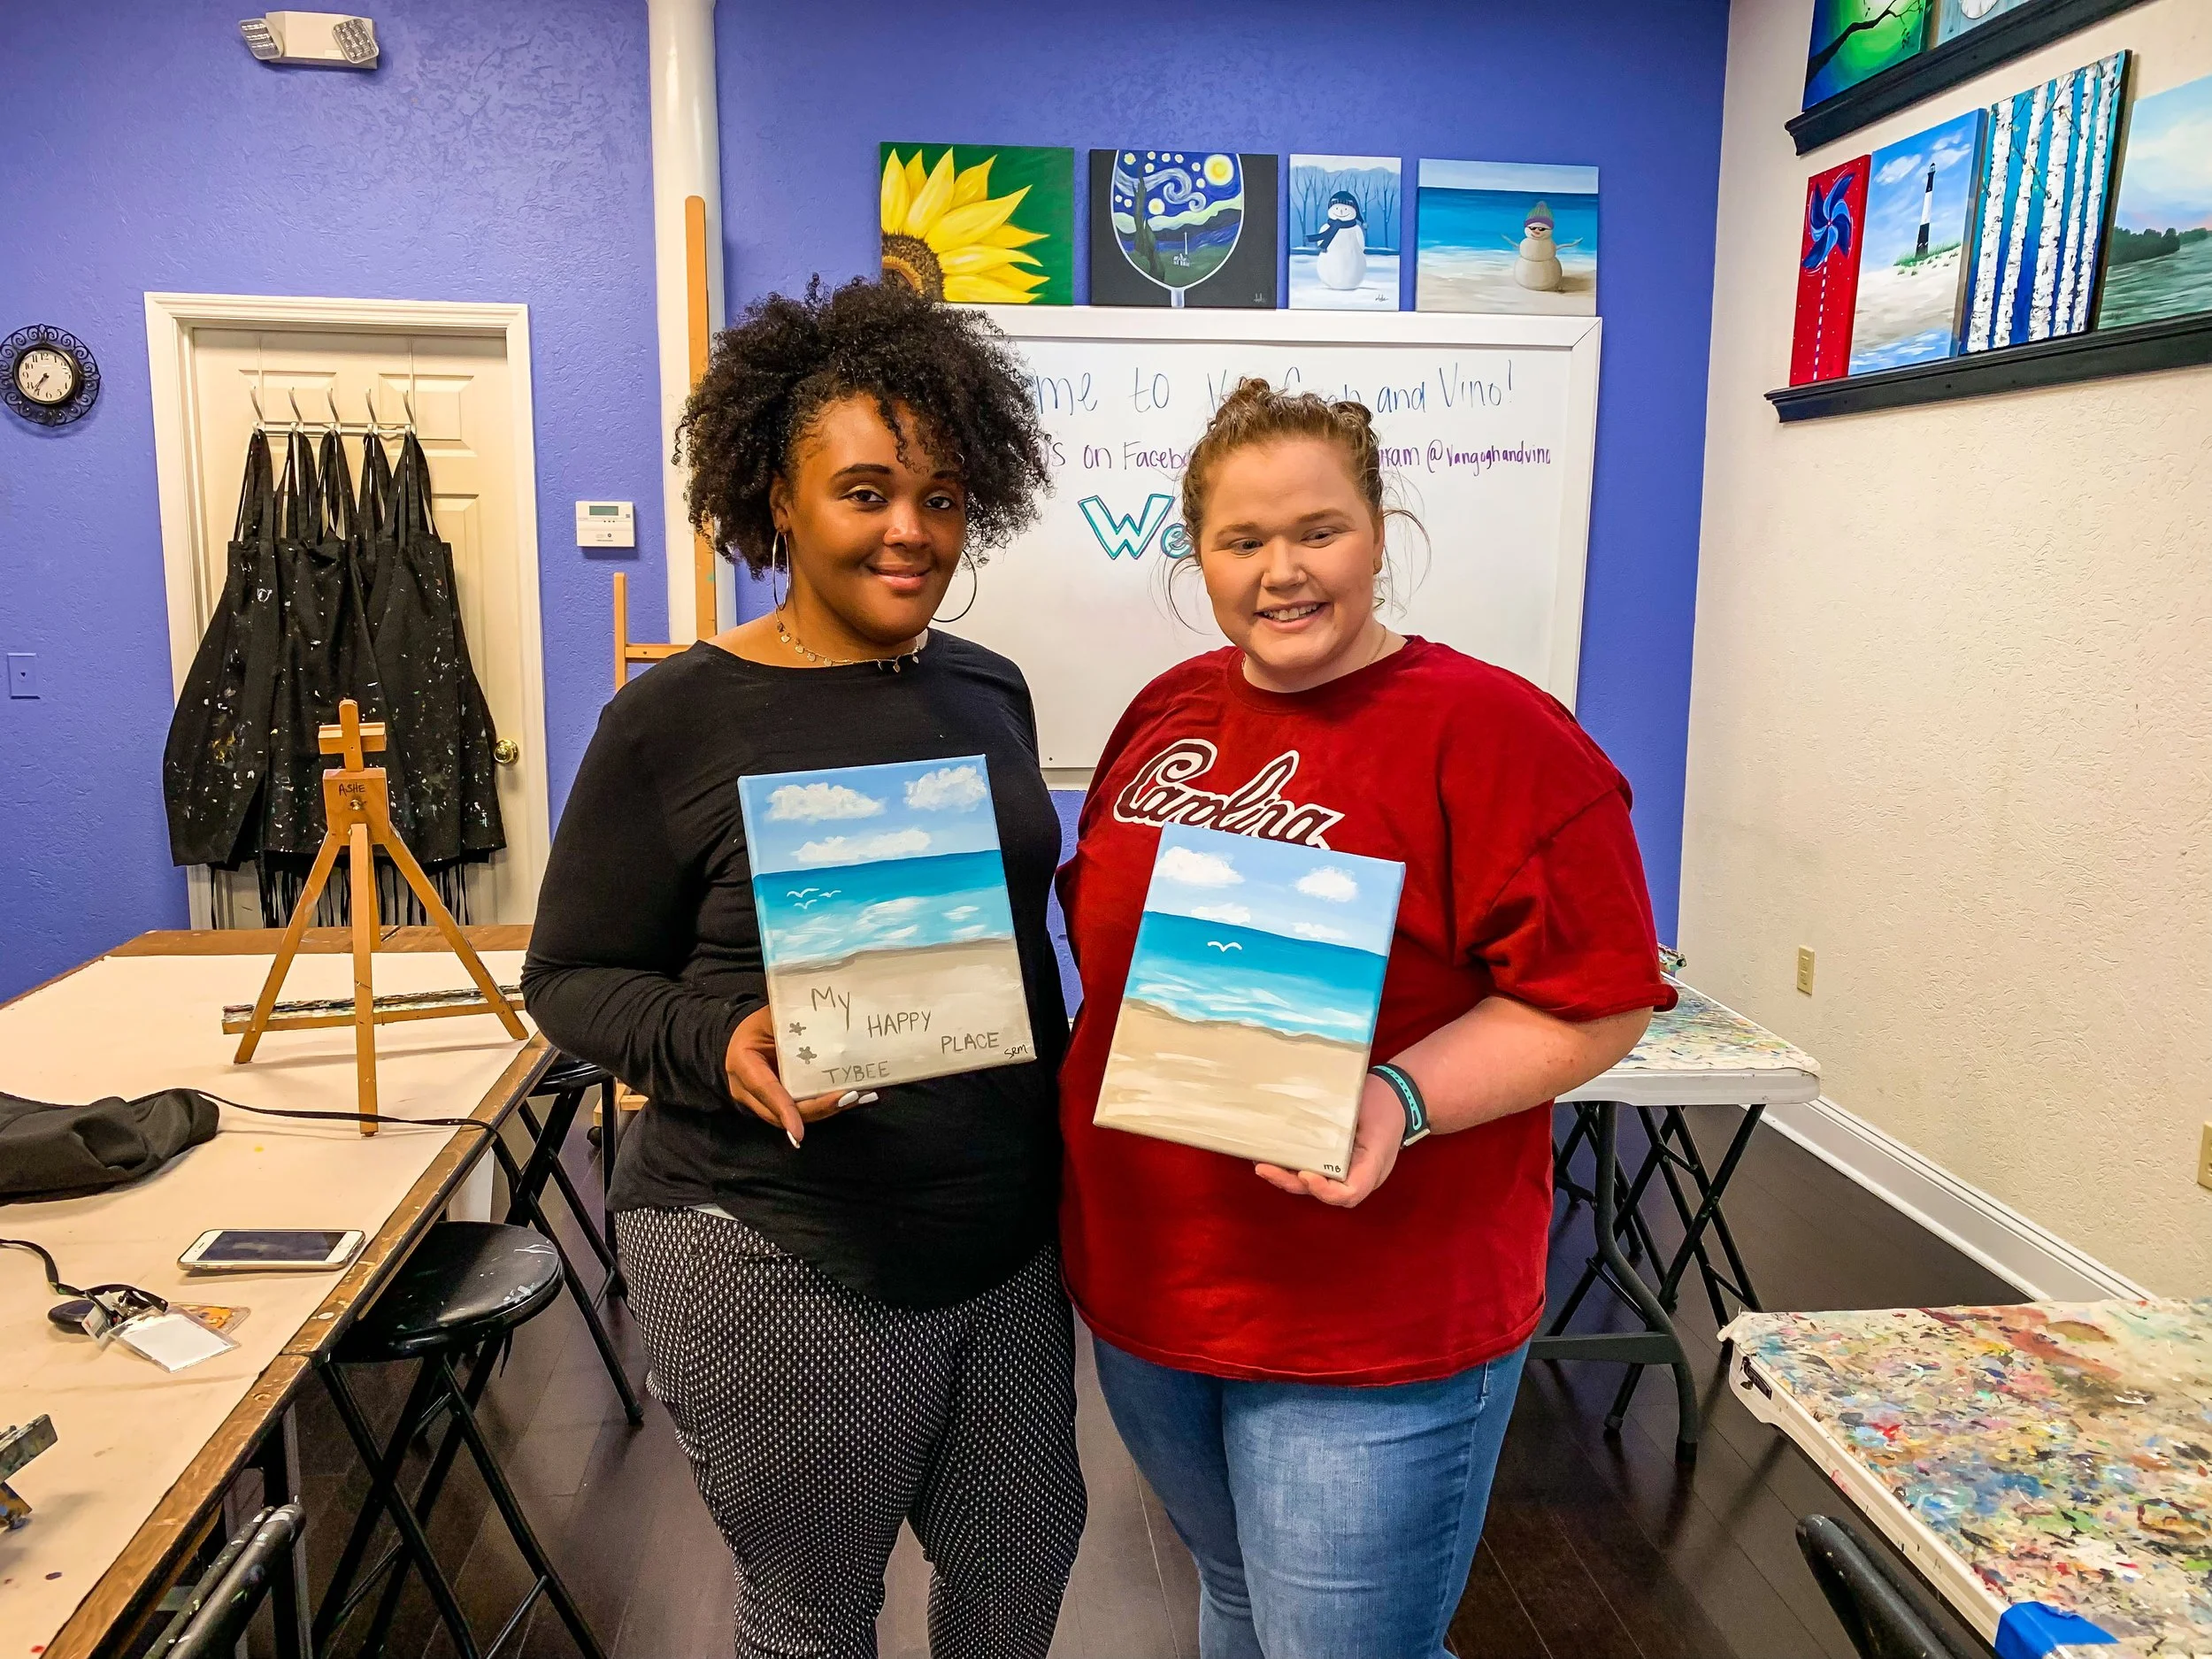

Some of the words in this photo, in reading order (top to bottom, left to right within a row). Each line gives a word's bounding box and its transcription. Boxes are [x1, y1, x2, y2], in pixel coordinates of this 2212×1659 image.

[40, 352, 50, 361] 12
[1129, 367, 1169, 412] to
[1378, 381, 1426, 413] and
[1439, 359, 1512, 407] Vino!
[1084, 444, 1111, 469] on
[1124, 441, 1188, 470] Faceb
[338, 783, 365, 795] ASHE
[1113, 739, 1346, 850] Carolina
[867, 1010, 932, 1038] HAPPY
[941, 1032, 1000, 1055] PLACE
[821, 1060, 891, 1084] TYBEE
